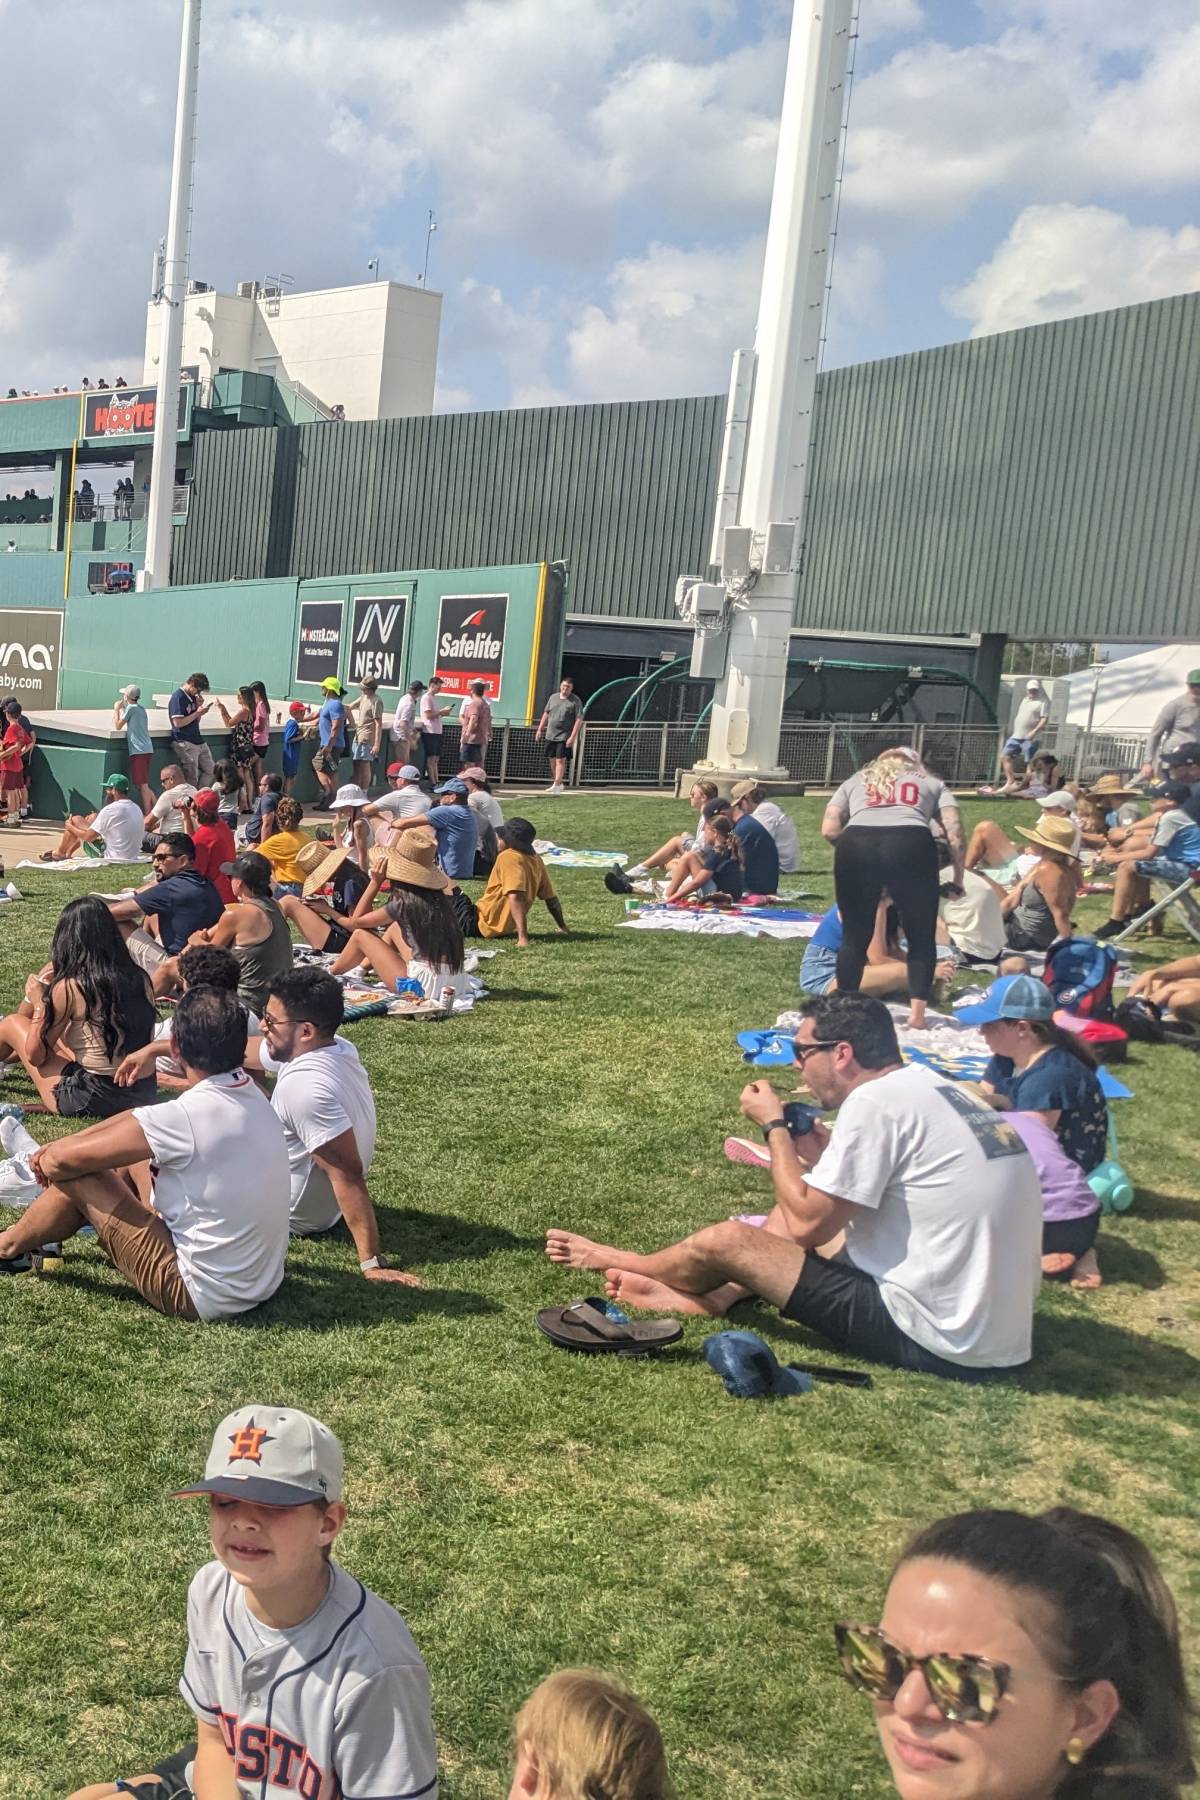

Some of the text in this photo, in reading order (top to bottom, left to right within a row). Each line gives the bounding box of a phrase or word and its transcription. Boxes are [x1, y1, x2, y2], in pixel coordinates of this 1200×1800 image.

[94, 402, 156, 432] HOOTE
[440, 631, 500, 659] Safelite
[354, 651, 395, 680] NESN
[440, 677, 460, 688] EPAIR
[227, 1428, 268, 1460] H
